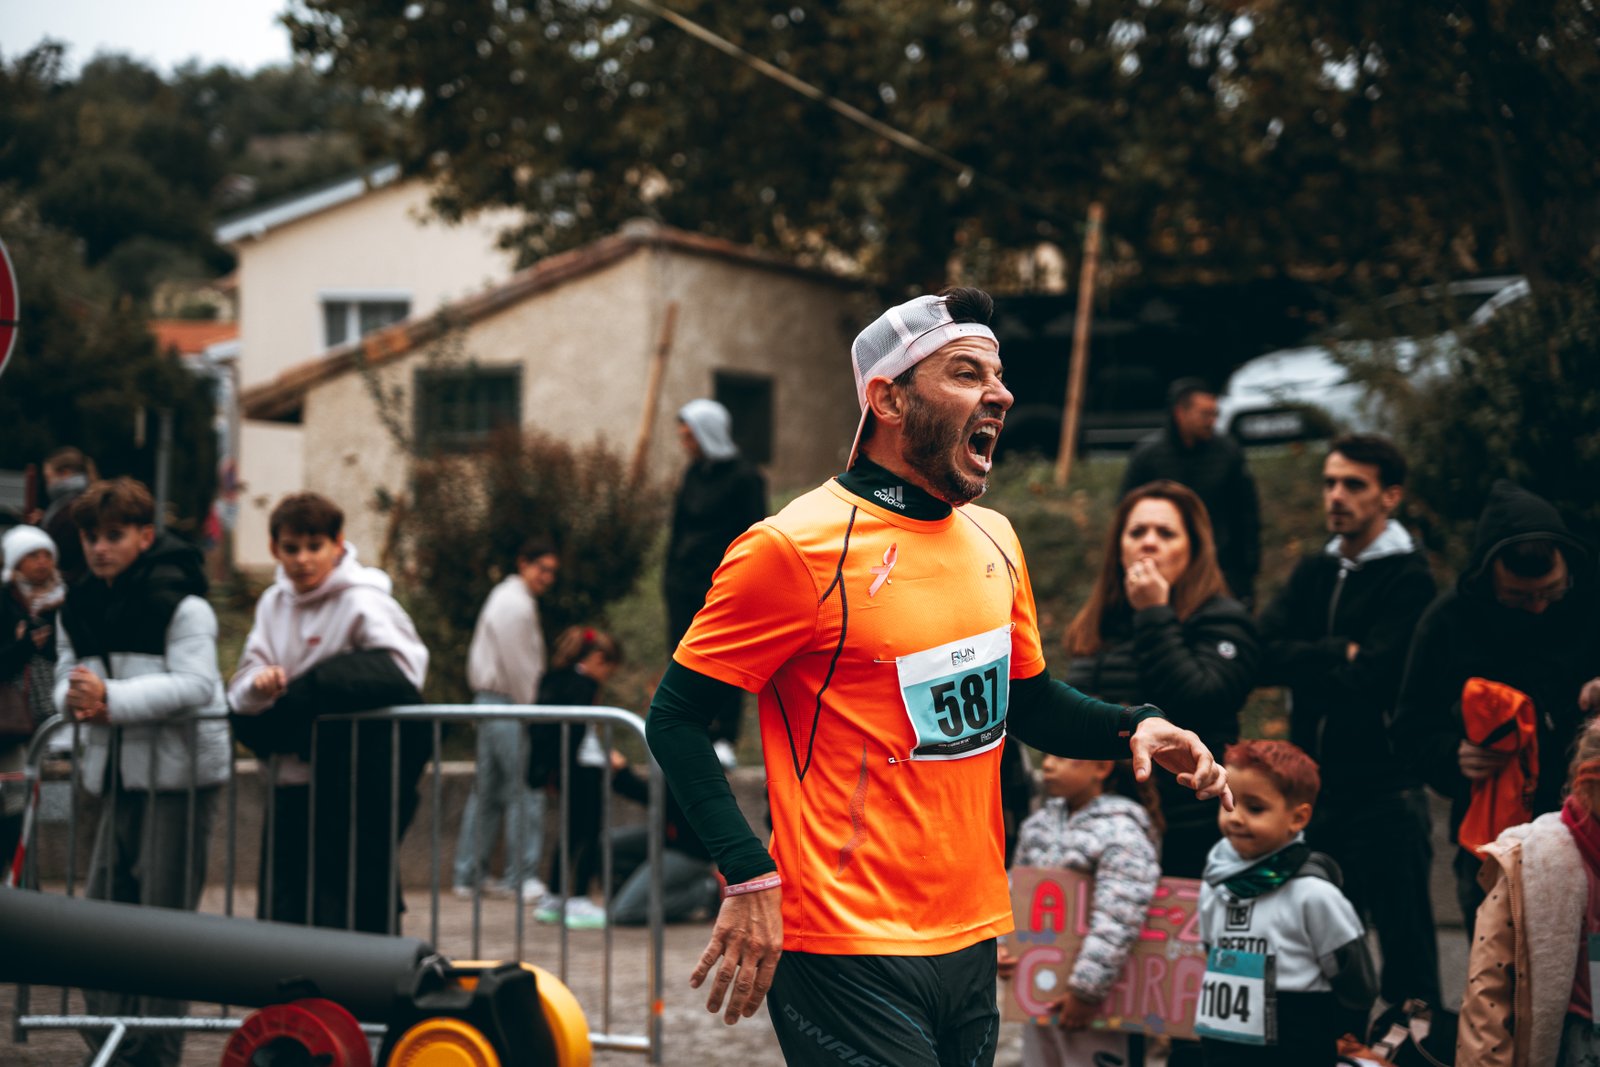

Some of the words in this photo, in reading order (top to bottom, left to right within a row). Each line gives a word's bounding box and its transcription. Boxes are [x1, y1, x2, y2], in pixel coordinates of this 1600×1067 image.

[874, 490, 906, 509] adidas
[951, 647, 975, 662] RUN
[930, 667, 997, 737] 587
[1031, 881, 1200, 941] ALEZ
[1016, 948, 1206, 1024] CARA
[1201, 981, 1250, 1022] 1104
[784, 1004, 891, 1066] DYNAF
